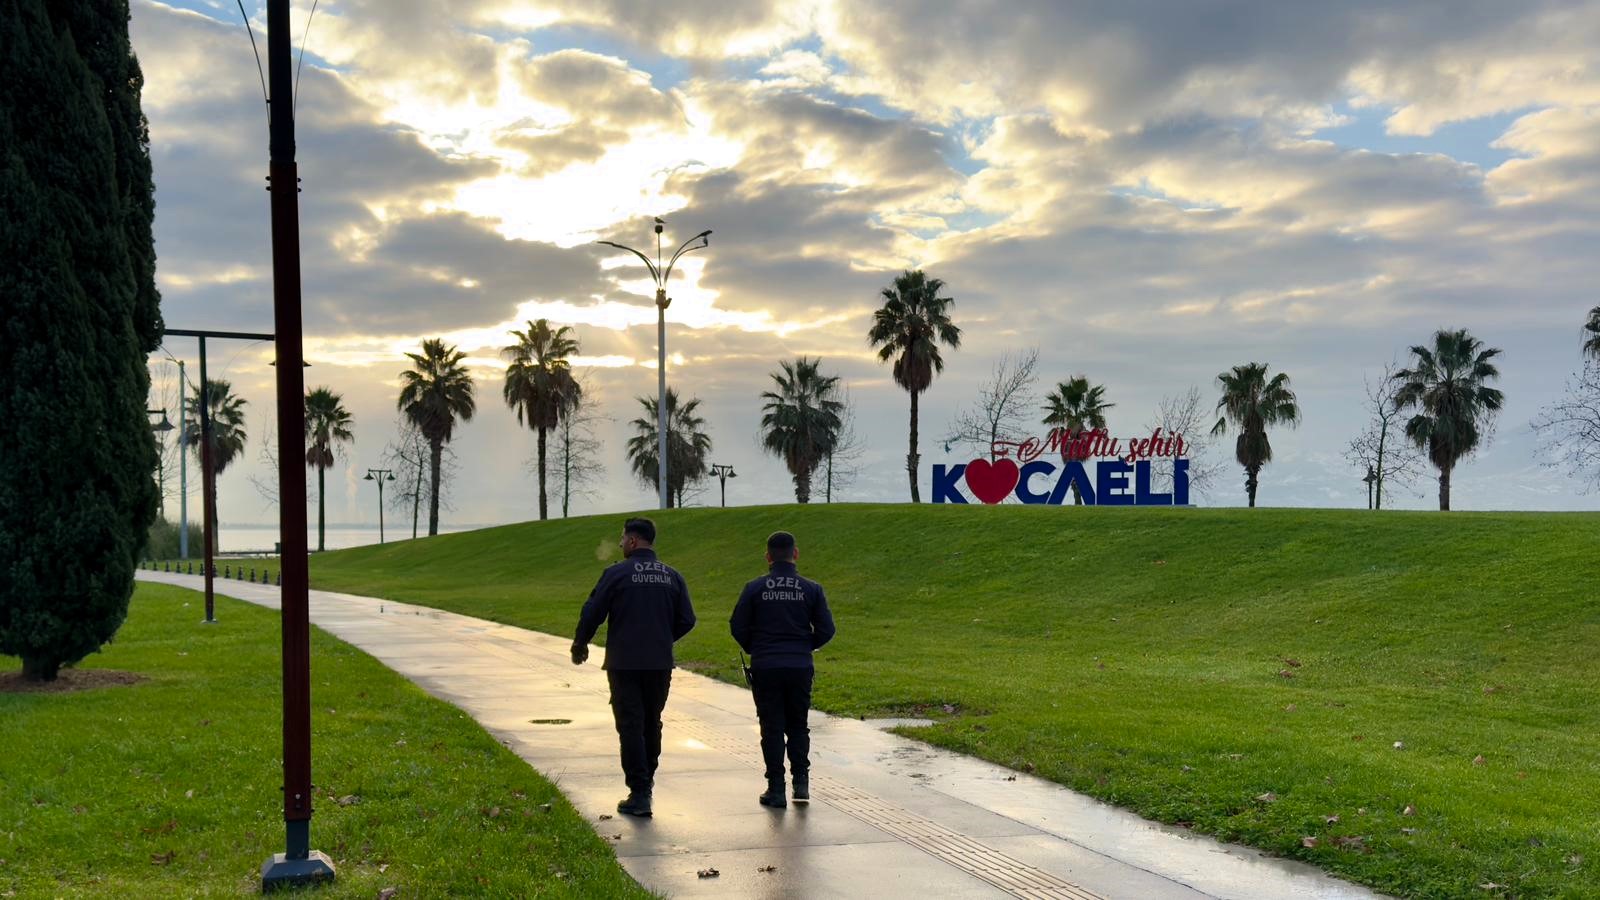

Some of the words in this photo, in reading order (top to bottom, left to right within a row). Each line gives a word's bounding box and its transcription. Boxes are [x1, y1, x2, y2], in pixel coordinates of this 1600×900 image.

[992, 427, 1121, 462] Mutlu
[1126, 427, 1190, 462] şehir
[634, 561, 669, 574] ÖZEL
[631, 573, 672, 584] GÜVENLİK
[766, 576, 802, 590] ÖZEL
[762, 589, 805, 601] GÜVENLİK
